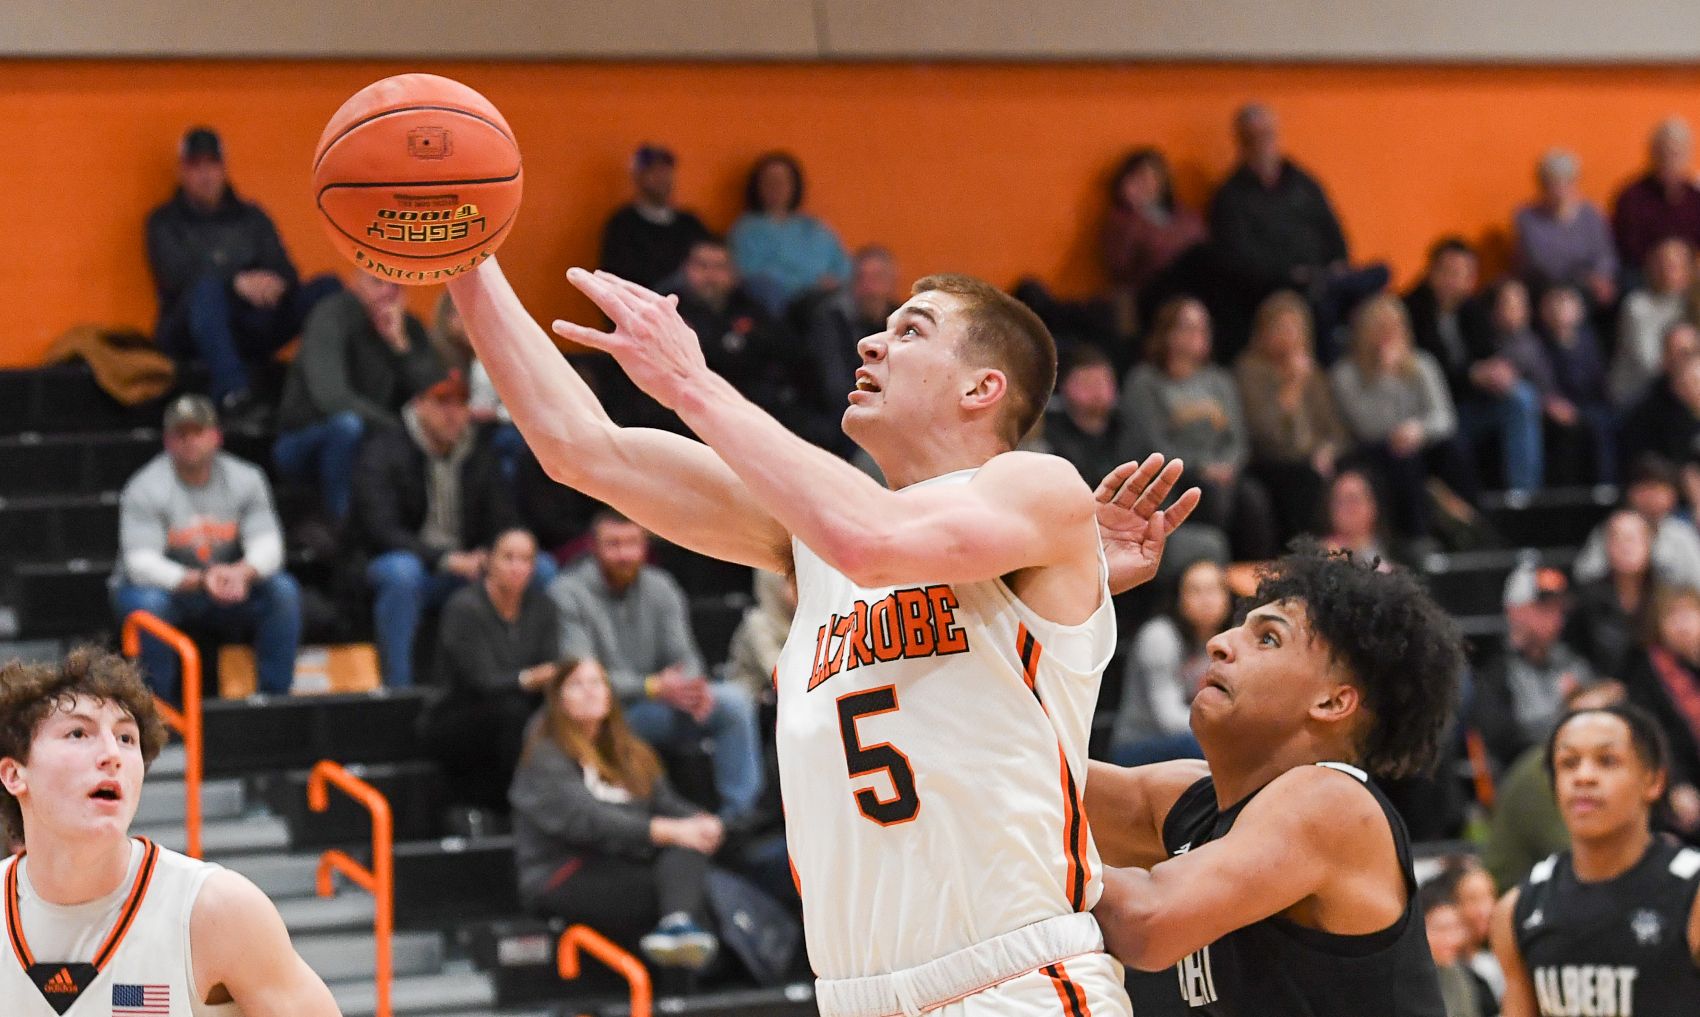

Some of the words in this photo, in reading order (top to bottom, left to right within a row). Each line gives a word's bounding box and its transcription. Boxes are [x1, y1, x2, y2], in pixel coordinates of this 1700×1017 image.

[366, 216, 487, 242] LEGACY
[377, 208, 452, 222] 1000
[352, 247, 492, 281] SPALDING
[836, 684, 921, 827] 5
